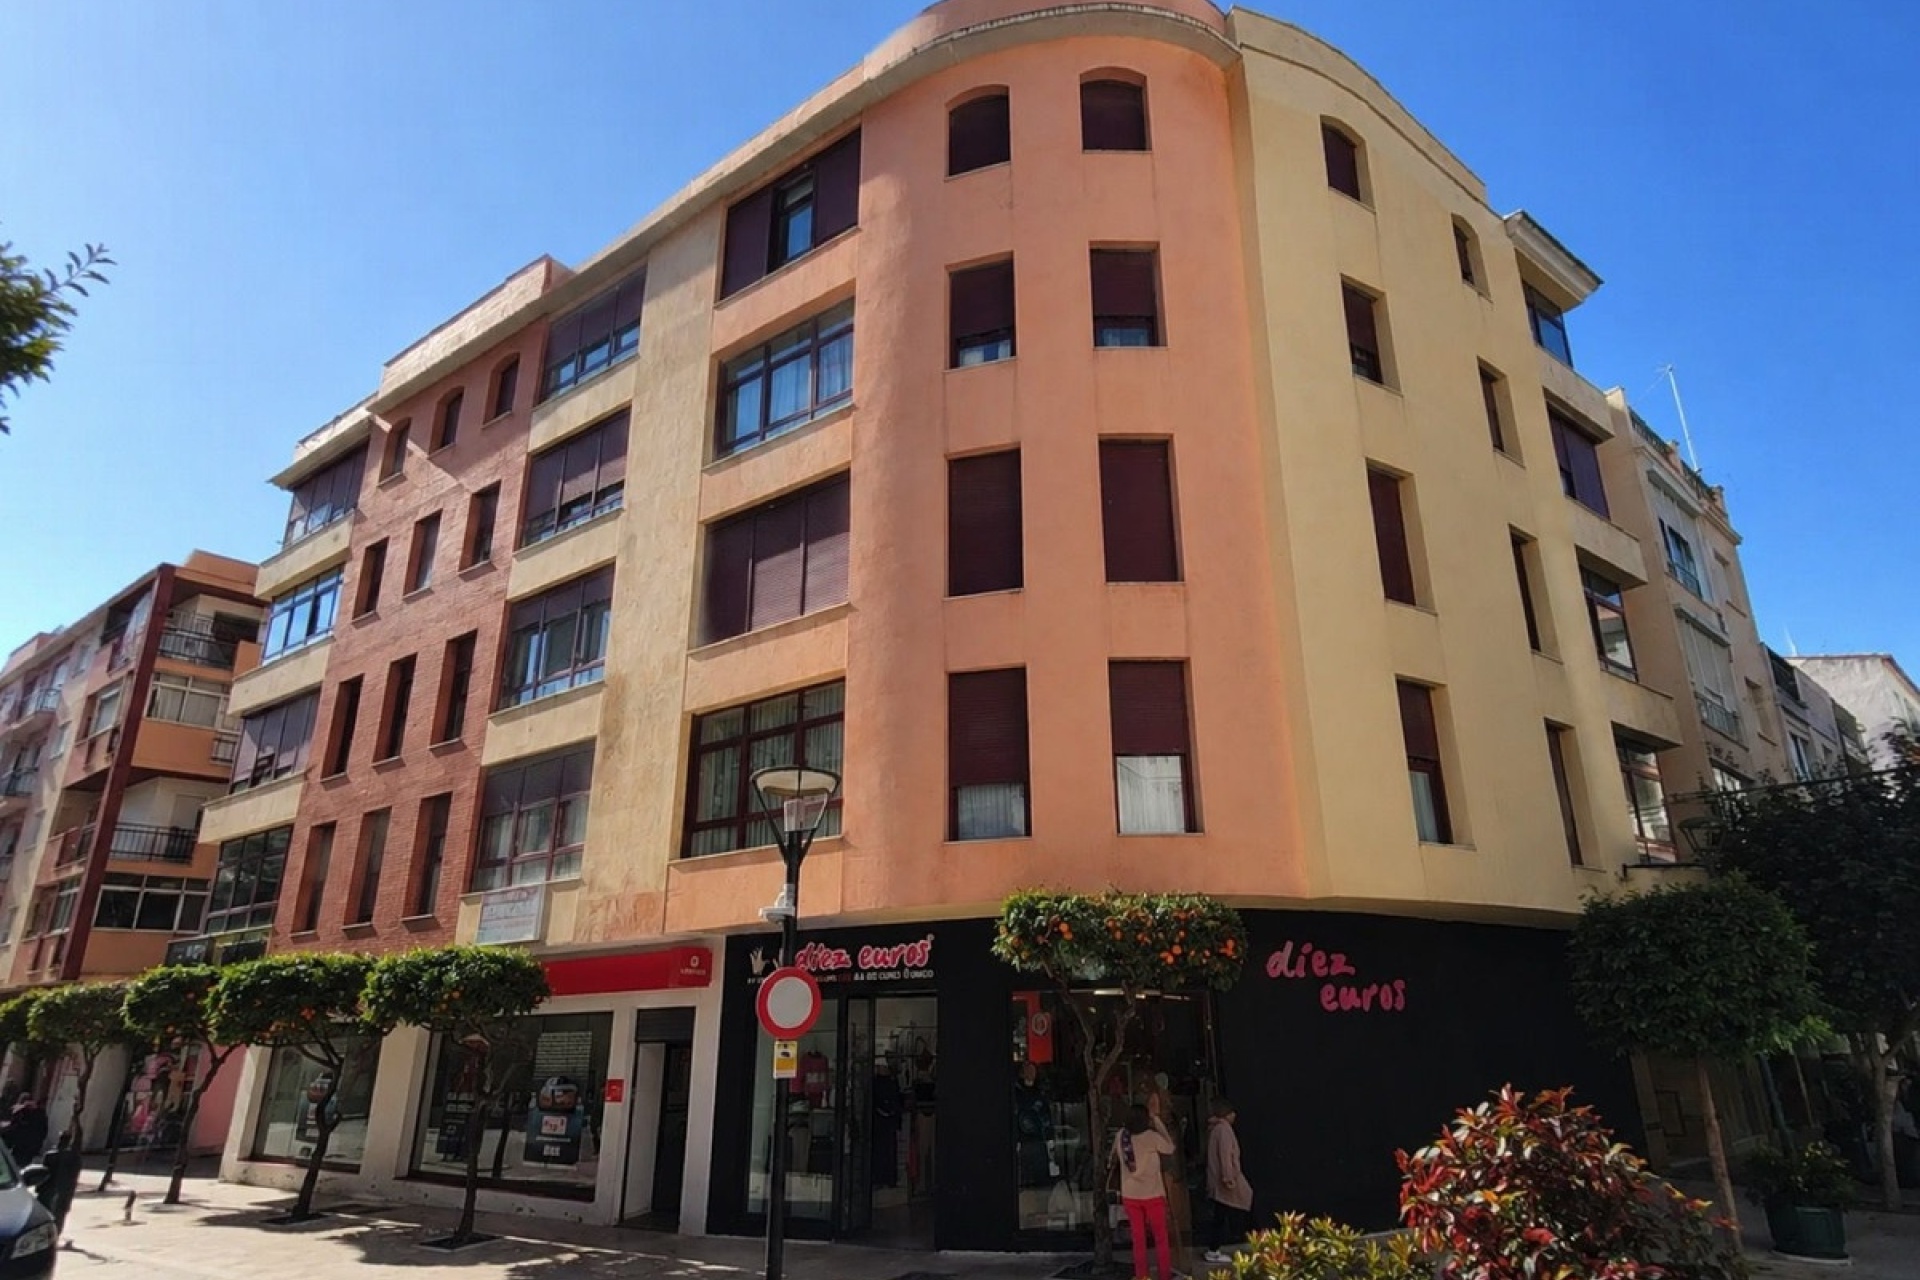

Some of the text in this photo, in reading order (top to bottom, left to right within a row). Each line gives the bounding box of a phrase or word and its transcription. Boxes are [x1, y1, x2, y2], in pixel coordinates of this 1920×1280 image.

[795, 939, 932, 971] diez euros
[1266, 940, 1356, 978] diez
[1320, 979, 1406, 1012] euros
